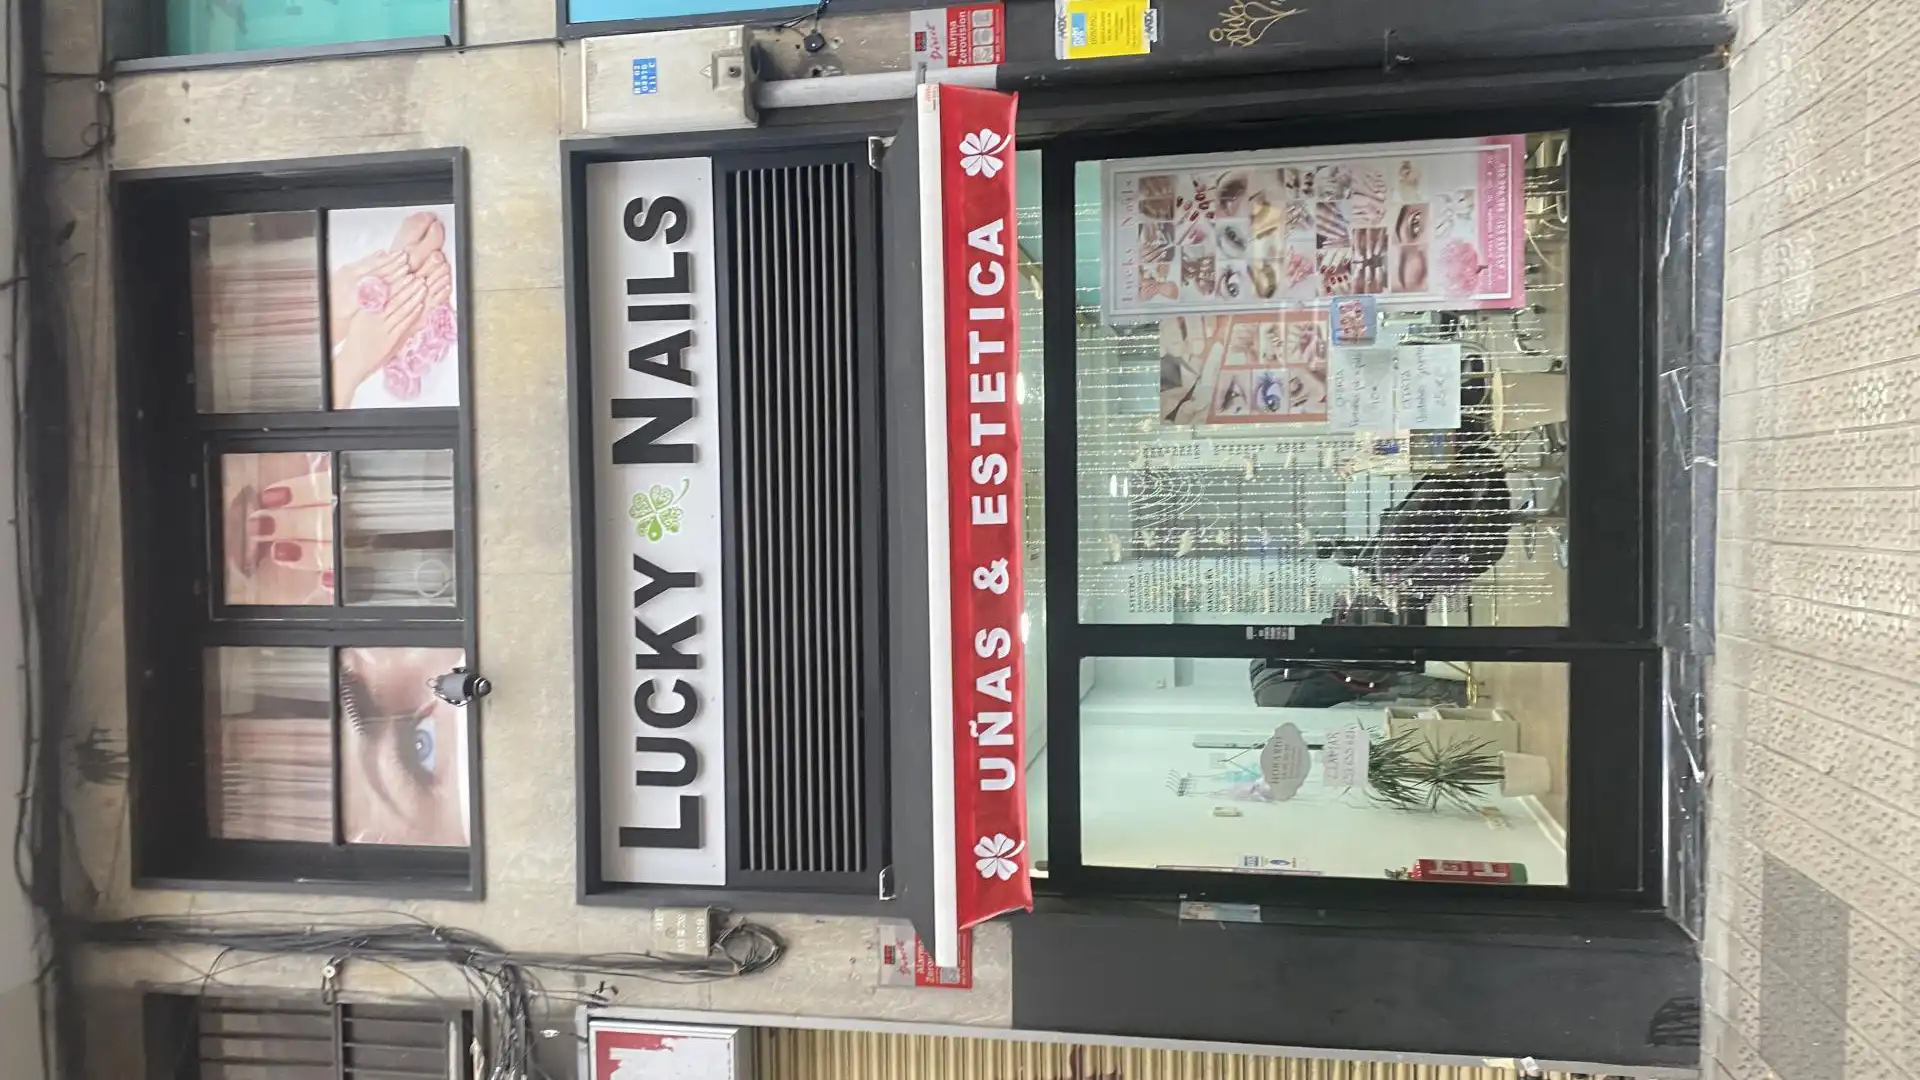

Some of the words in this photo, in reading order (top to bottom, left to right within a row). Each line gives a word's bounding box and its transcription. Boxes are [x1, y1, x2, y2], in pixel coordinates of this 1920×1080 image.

[948, 20, 957, 57] Alarma
[956, 10, 968, 65] Zerovision
[611, 195, 696, 464] NAILS
[966, 217, 1008, 524] ESTETICA
[973, 558, 1010, 595] &
[619, 553, 703, 850] LUCKY
[968, 627, 1016, 791] UÑAS
